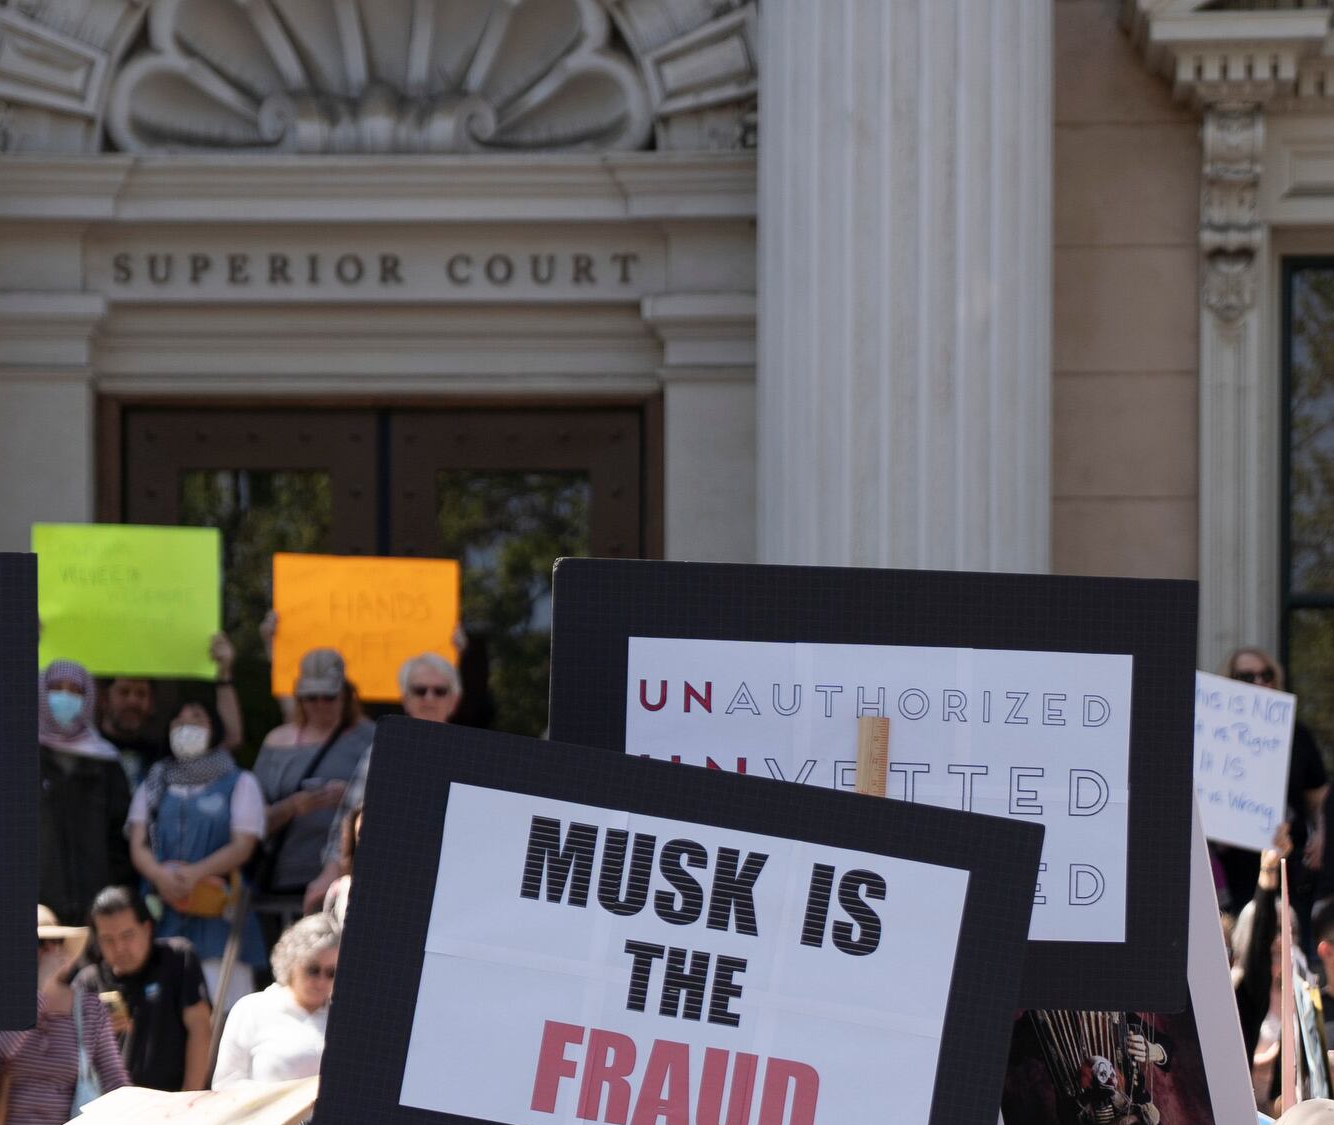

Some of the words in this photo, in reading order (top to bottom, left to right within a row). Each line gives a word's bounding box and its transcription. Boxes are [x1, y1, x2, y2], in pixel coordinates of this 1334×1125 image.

[112, 251, 405, 288] SUPERIOR
[448, 251, 642, 288] COURT
[639, 679, 1112, 729] UNAUTHORIZED
[1252, 693, 1293, 726] NOT
[639, 755, 1111, 817] VTTED
[520, 814, 770, 938] MUSK
[800, 862, 889, 958] IS
[622, 939, 750, 1029] THE
